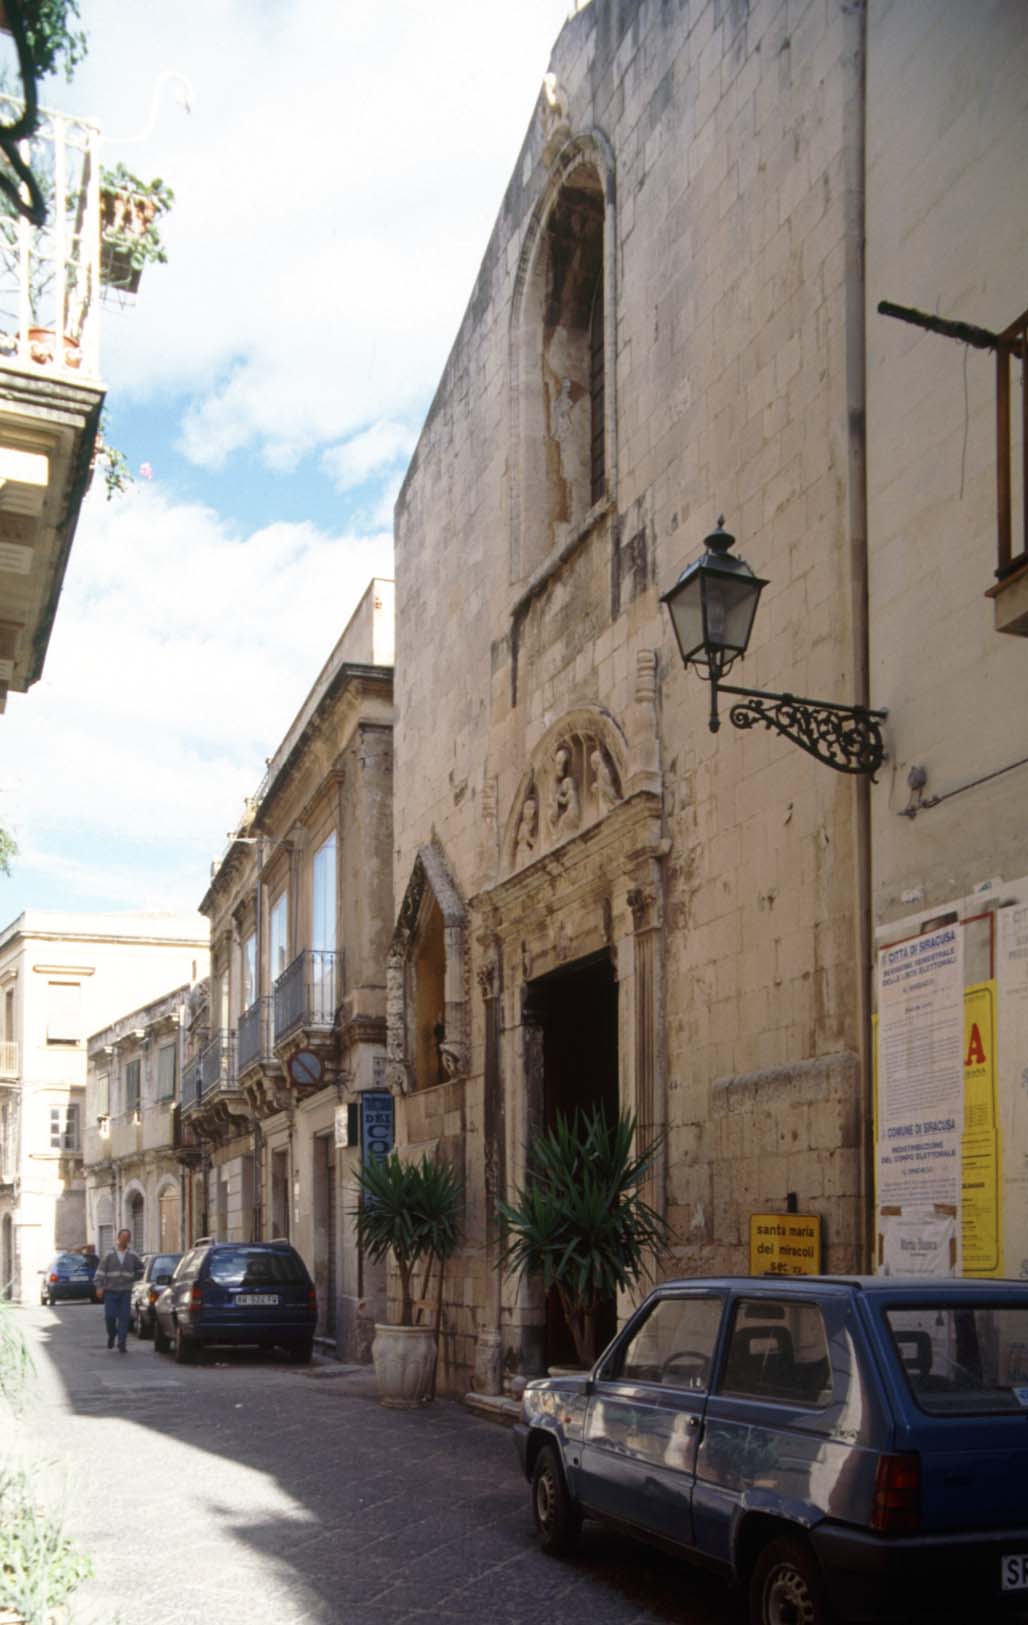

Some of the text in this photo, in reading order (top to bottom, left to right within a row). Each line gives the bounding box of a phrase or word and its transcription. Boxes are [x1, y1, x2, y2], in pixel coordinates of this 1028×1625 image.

[757, 1224, 815, 1237] santa maria
[779, 1244, 814, 1257] miracoli
